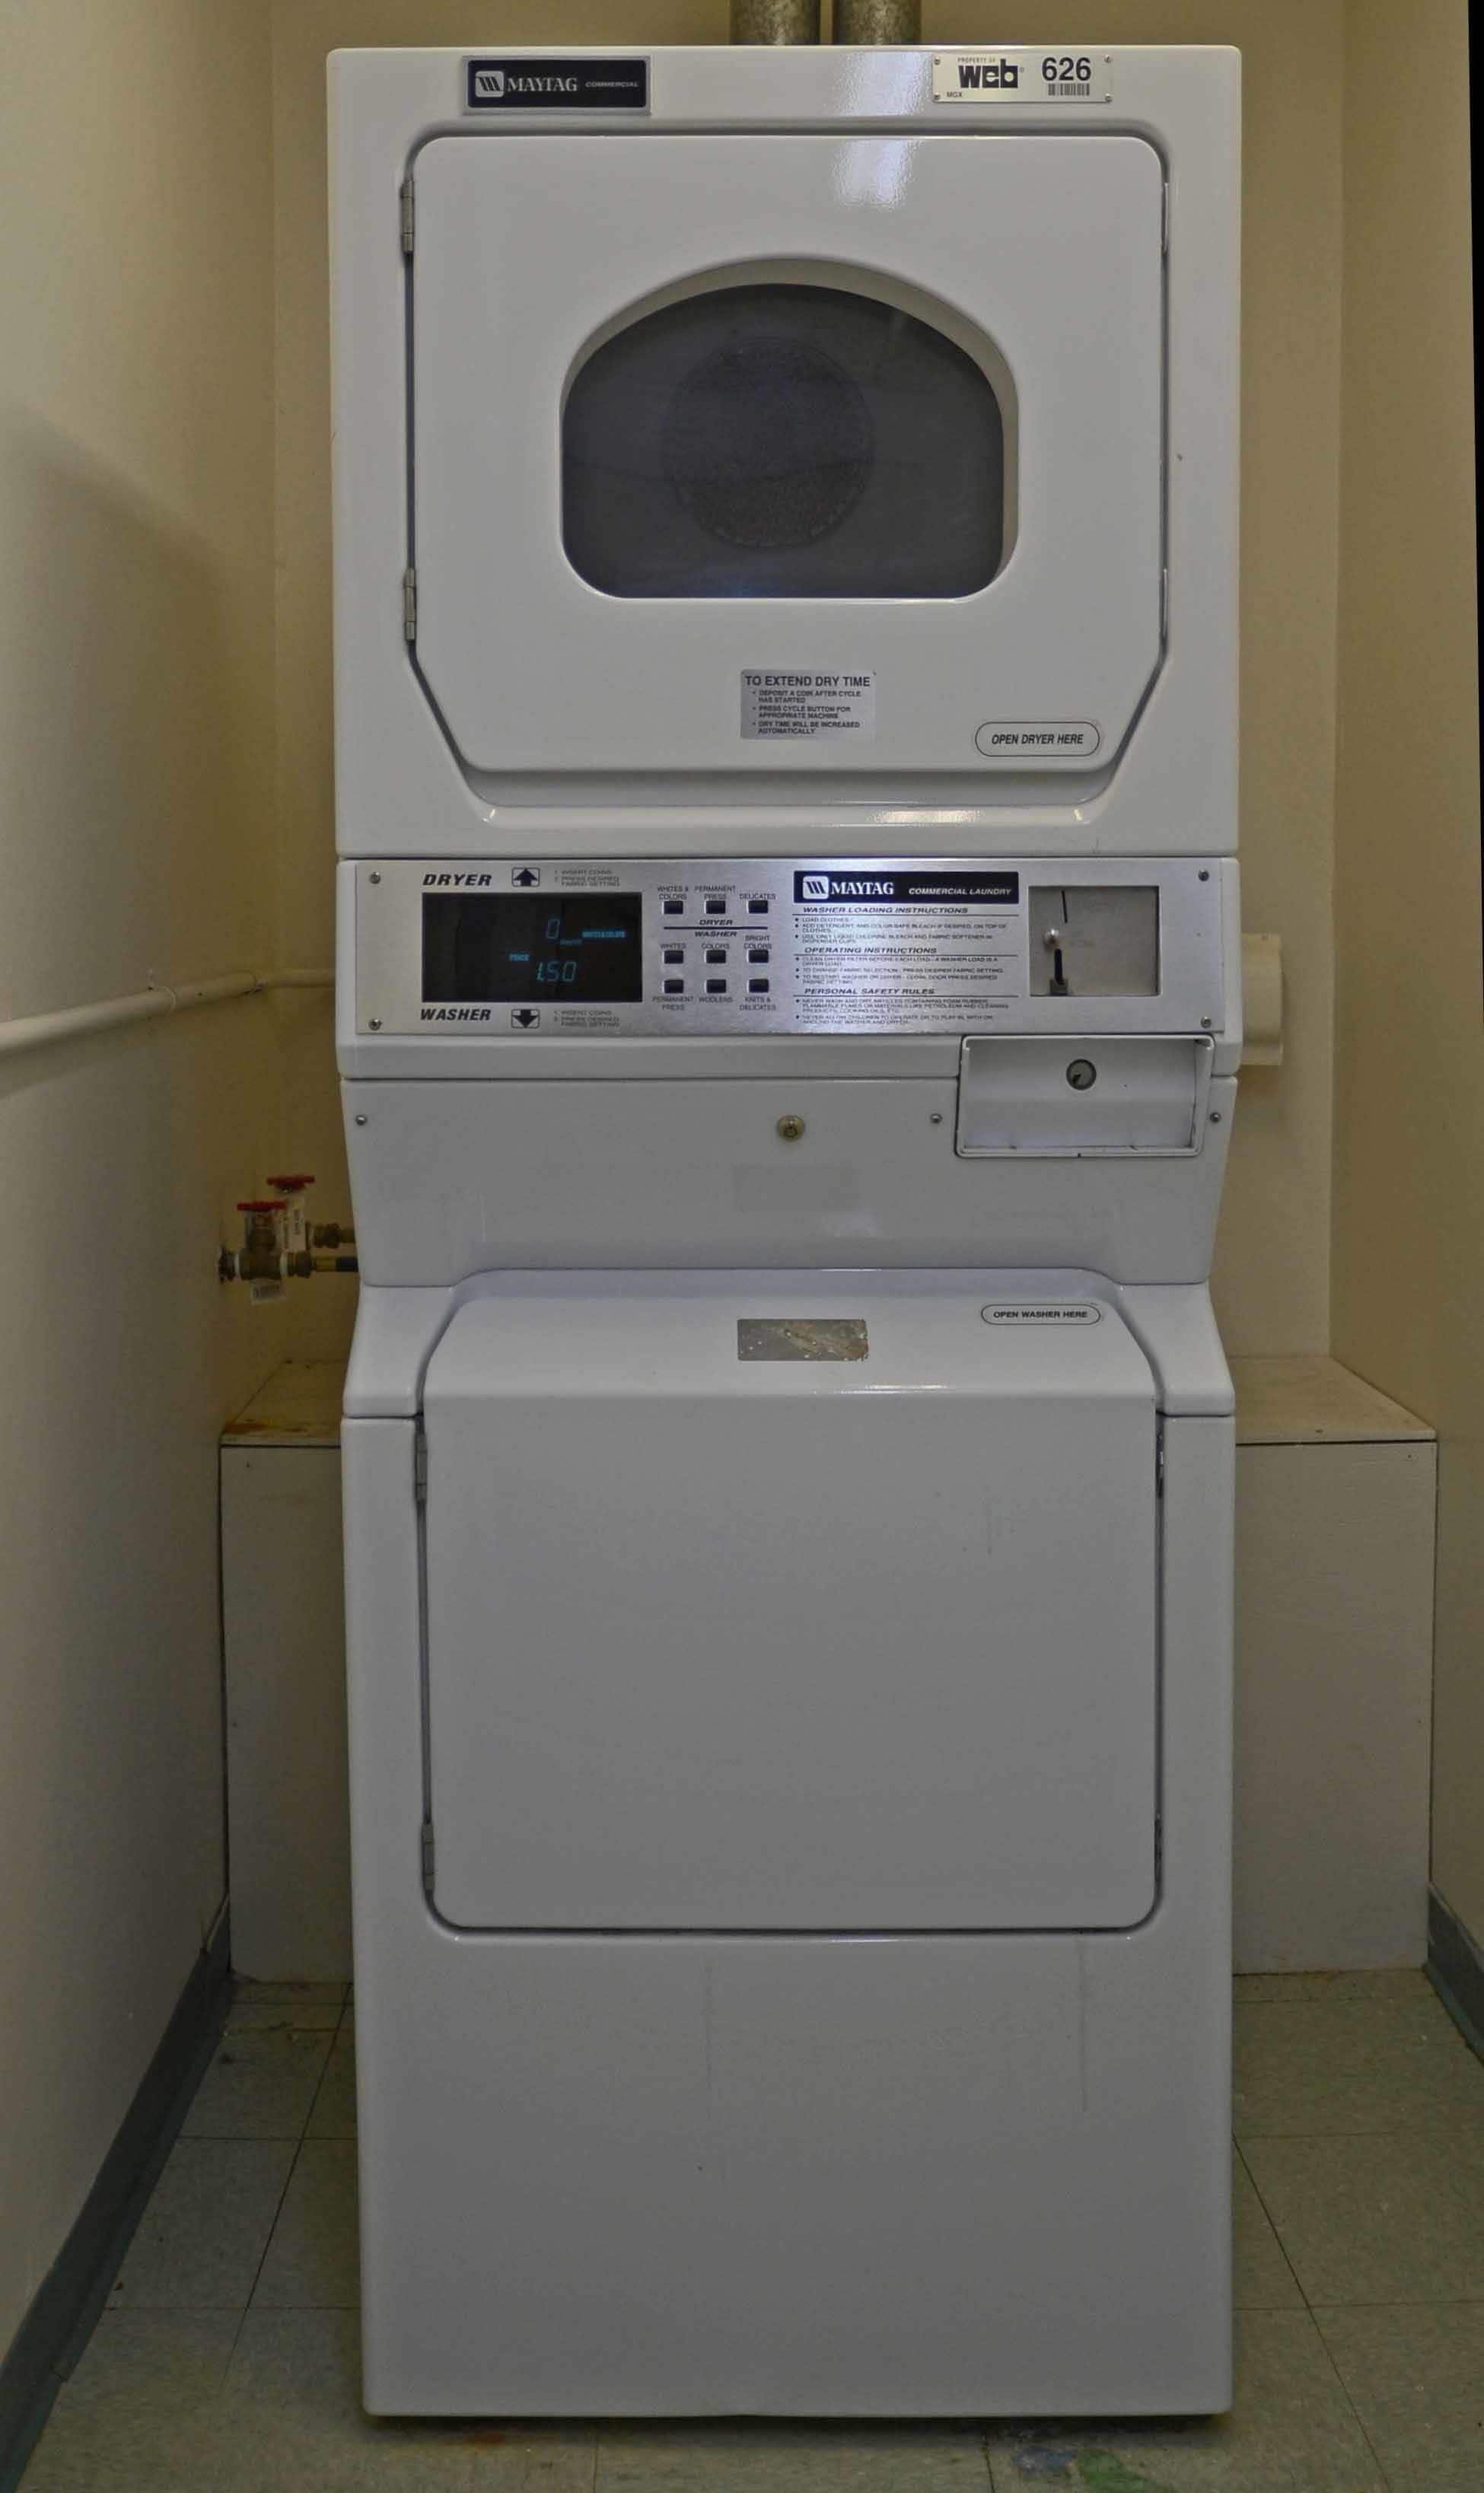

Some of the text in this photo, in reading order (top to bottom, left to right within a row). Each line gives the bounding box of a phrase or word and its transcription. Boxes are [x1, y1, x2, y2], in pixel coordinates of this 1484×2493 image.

[958, 59, 1018, 88] web
[1042, 57, 1091, 81] 626
[508, 78, 578, 92] MAYTAG
[745, 676, 871, 686] TO EXTEND DRY TIME
[992, 734, 1084, 744] OPEN DRYER HERE
[422, 874, 492, 886] DRYER
[831, 882, 894, 895] MAYTAG
[420, 1008, 491, 1020] WASHER
